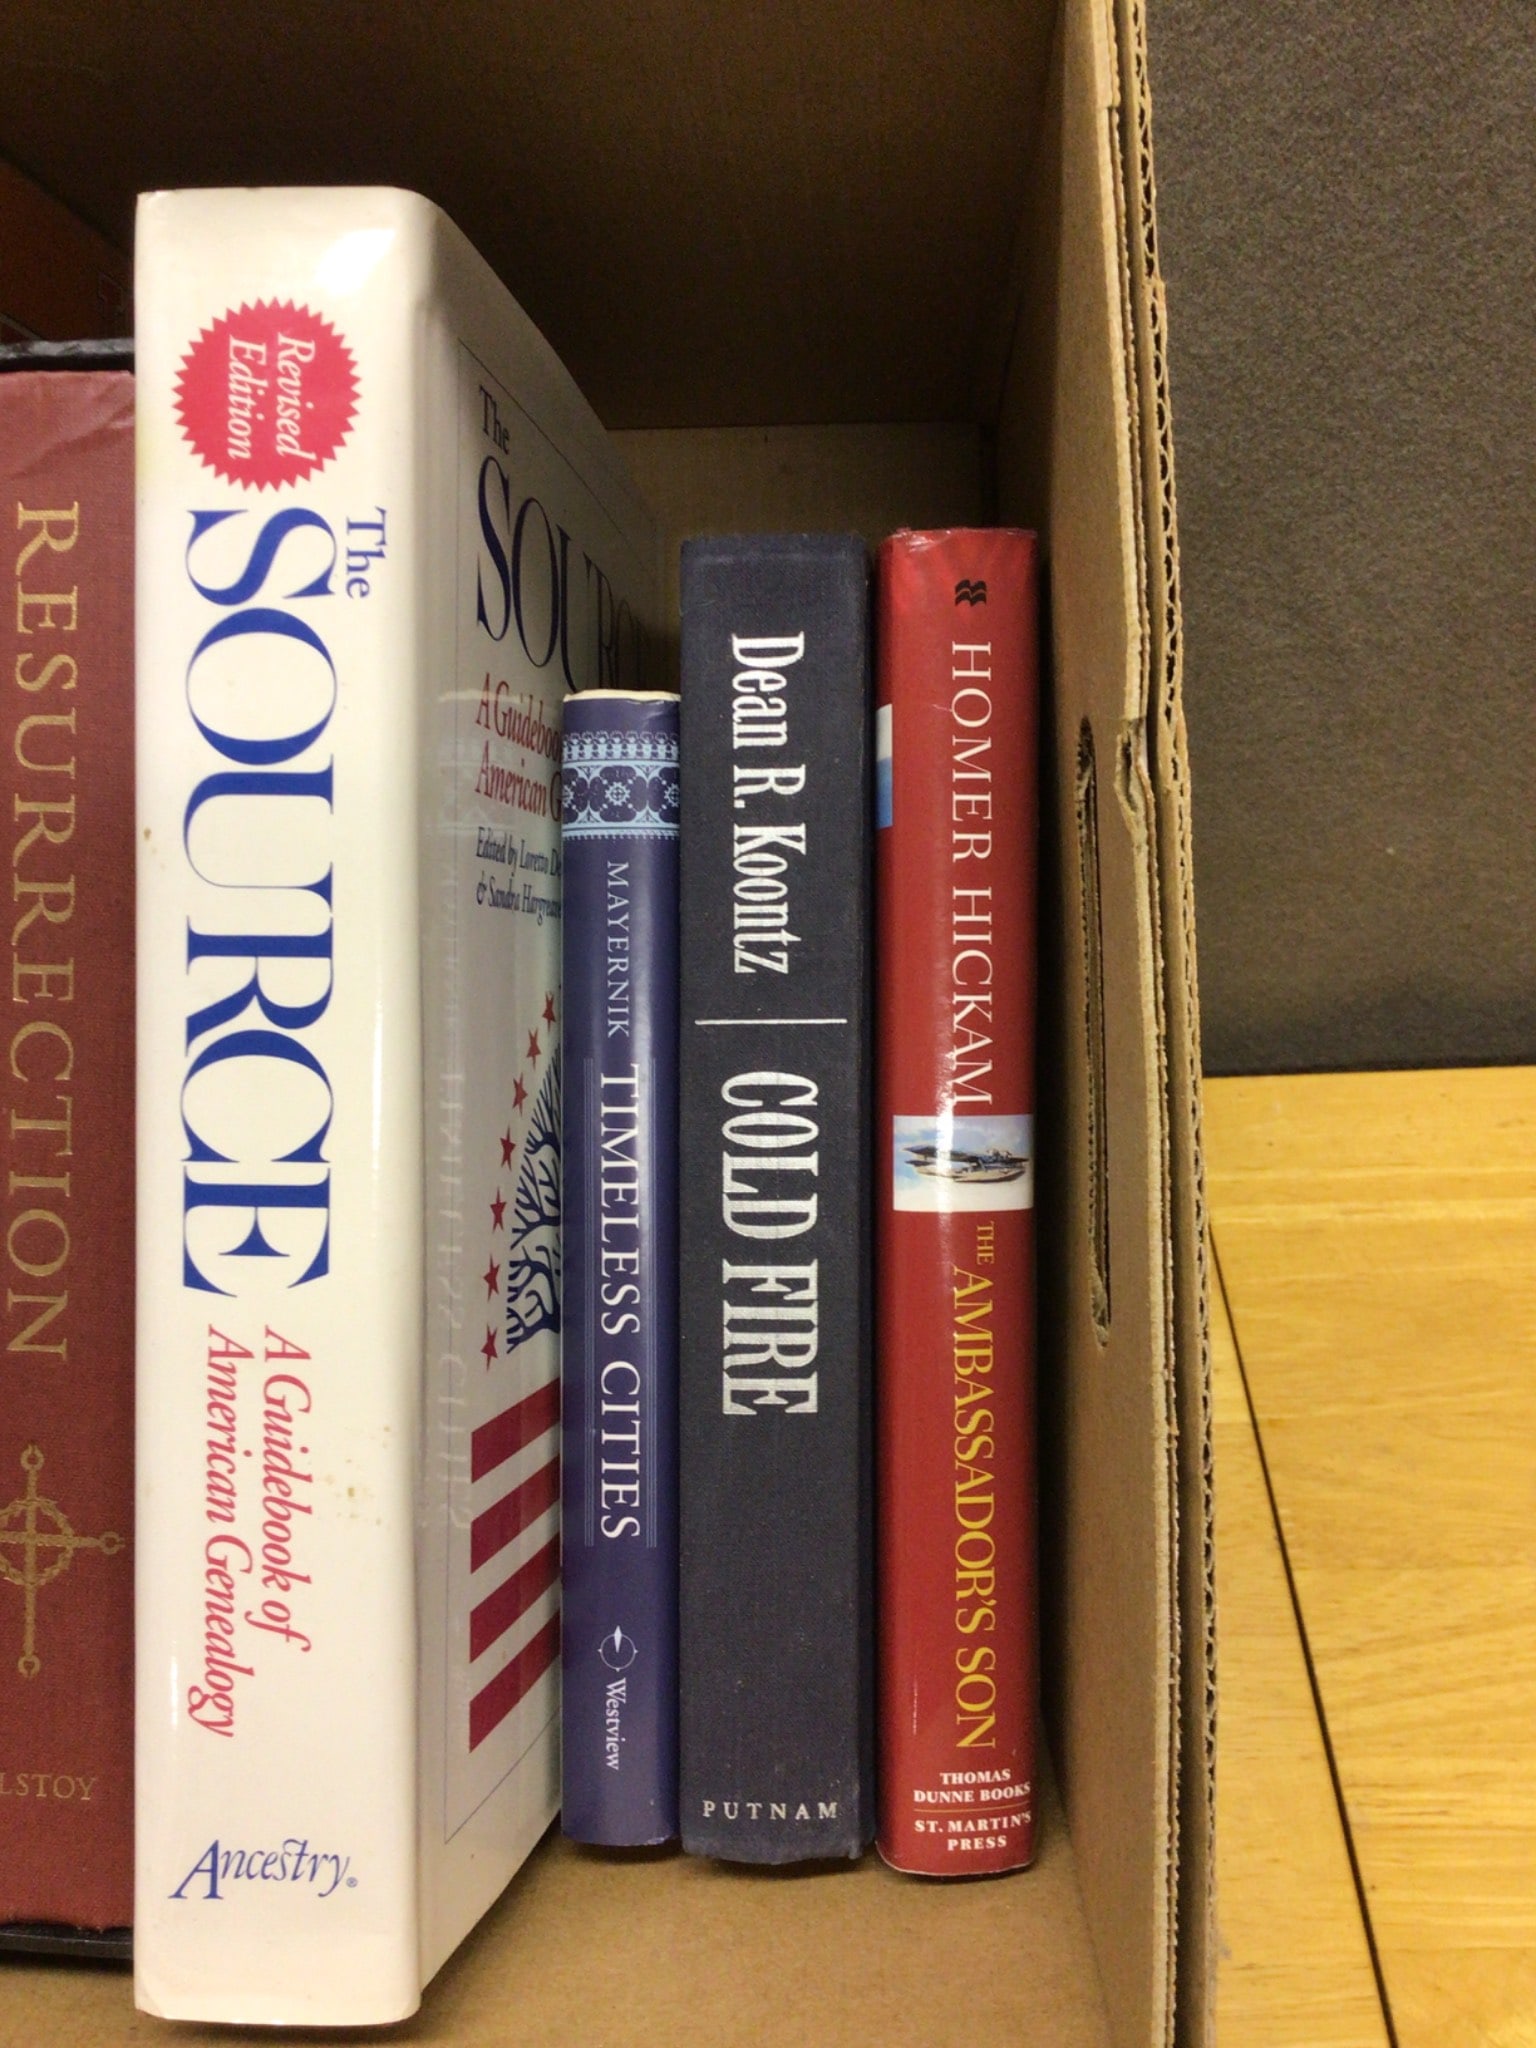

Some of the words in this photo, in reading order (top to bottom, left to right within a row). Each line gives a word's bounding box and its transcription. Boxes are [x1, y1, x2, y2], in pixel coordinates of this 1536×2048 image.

[227, 335, 269, 459] Edition
[275, 332, 317, 461] Revised
[480, 384, 510, 455] The
[346, 506, 388, 600] The
[475, 672, 491, 730] A
[731, 631, 806, 750] Dean
[474, 740, 547, 817] American
[733, 763, 807, 809] R.
[948, 640, 994, 864] HOMER
[6, 500, 79, 1361] RESURRECTION
[181, 506, 338, 1297] SOURCE
[607, 860, 632, 1039] MAYERNIK
[732, 822, 807, 974] Koontz
[948, 886, 994, 1106] HICKAM
[599, 1062, 642, 1335] TIMELESS
[721, 1071, 820, 1240] COLD
[975, 1221, 996, 1266] THE
[263, 1326, 313, 1361] A
[721, 1258, 819, 1416] FIRE
[206, 1325, 255, 1524] American
[262, 1373, 314, 1594] Guidebook
[599, 1360, 641, 1540] CITIES
[952, 1265, 998, 1635] AMBASSADOR'S
[187, 1533, 258, 1739] Genealogy
[244, 1599, 312, 1653] of
[605, 1676, 628, 1772] Westview
[954, 1646, 997, 1749] SON
[702, 1799, 839, 1821] PUTNAM
[913, 1789, 974, 1803] DUNNE
[979, 1781, 1031, 1802] BOOKS
[914, 1819, 943, 1833] ST.
[947, 1811, 1031, 1832] MARTIN'S
[939, 1768, 1011, 1785] THOMAS
[946, 1835, 1007, 1851] PRESS
